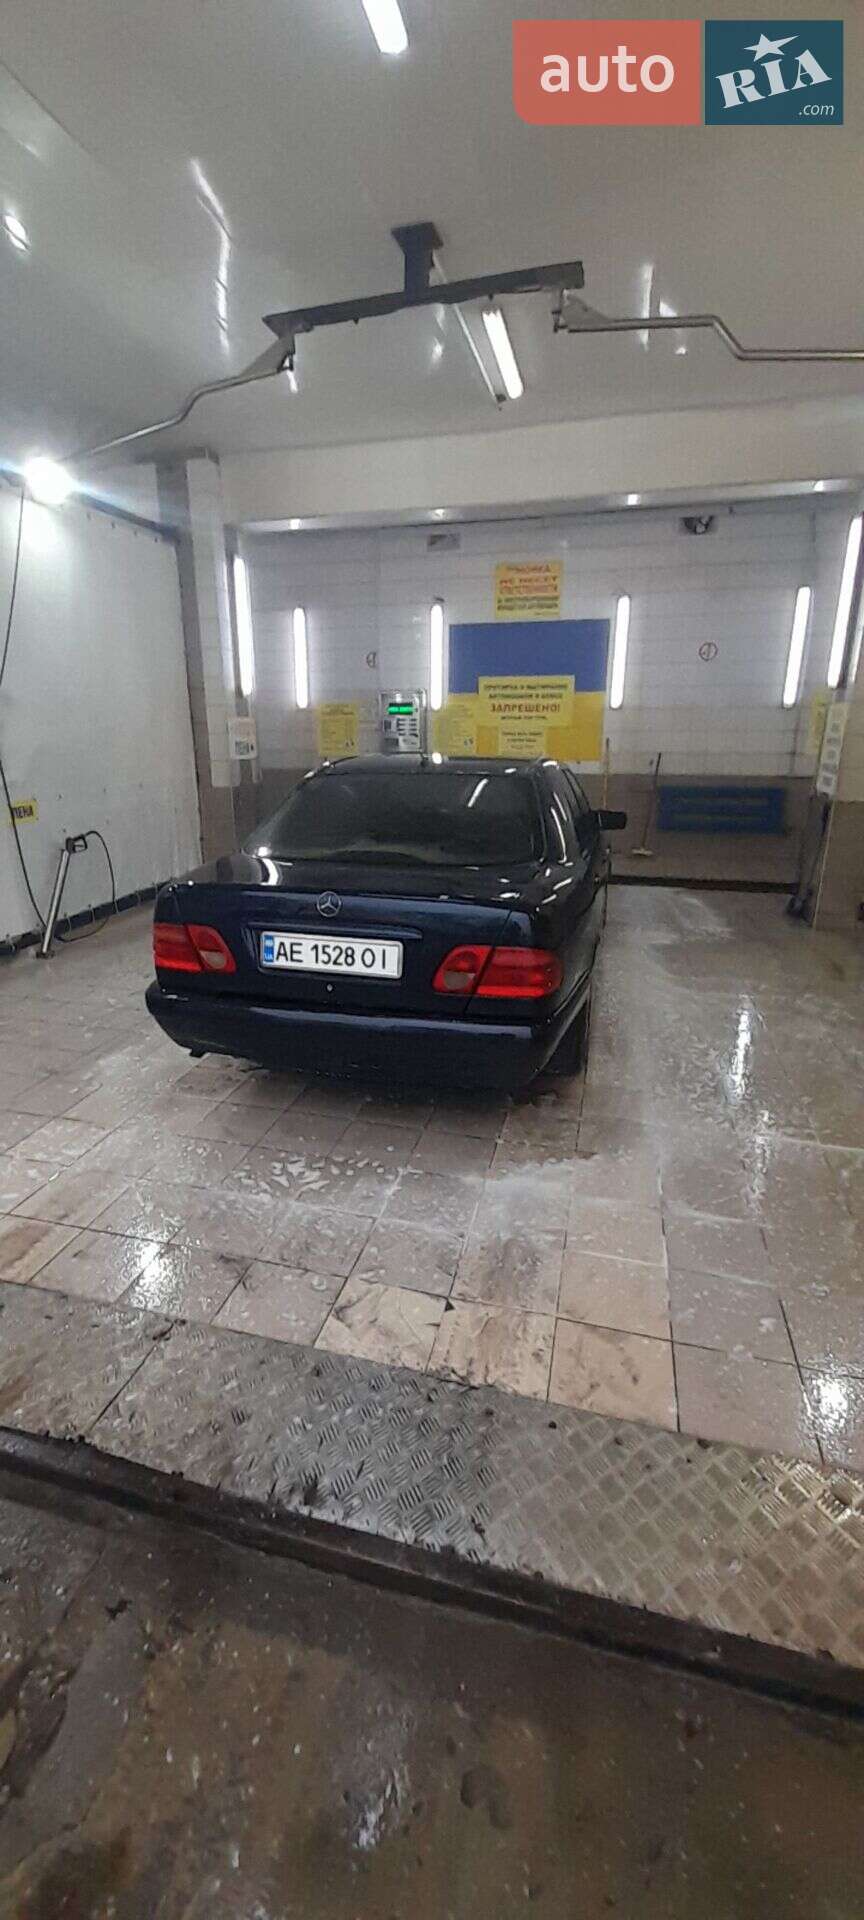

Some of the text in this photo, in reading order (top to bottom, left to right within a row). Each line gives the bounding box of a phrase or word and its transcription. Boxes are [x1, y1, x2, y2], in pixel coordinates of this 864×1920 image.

[490, 703, 560, 713] ЗАПРЕЩЕНО!
[276, 941, 304, 963] AE
[310, 944, 355, 967] 1528
